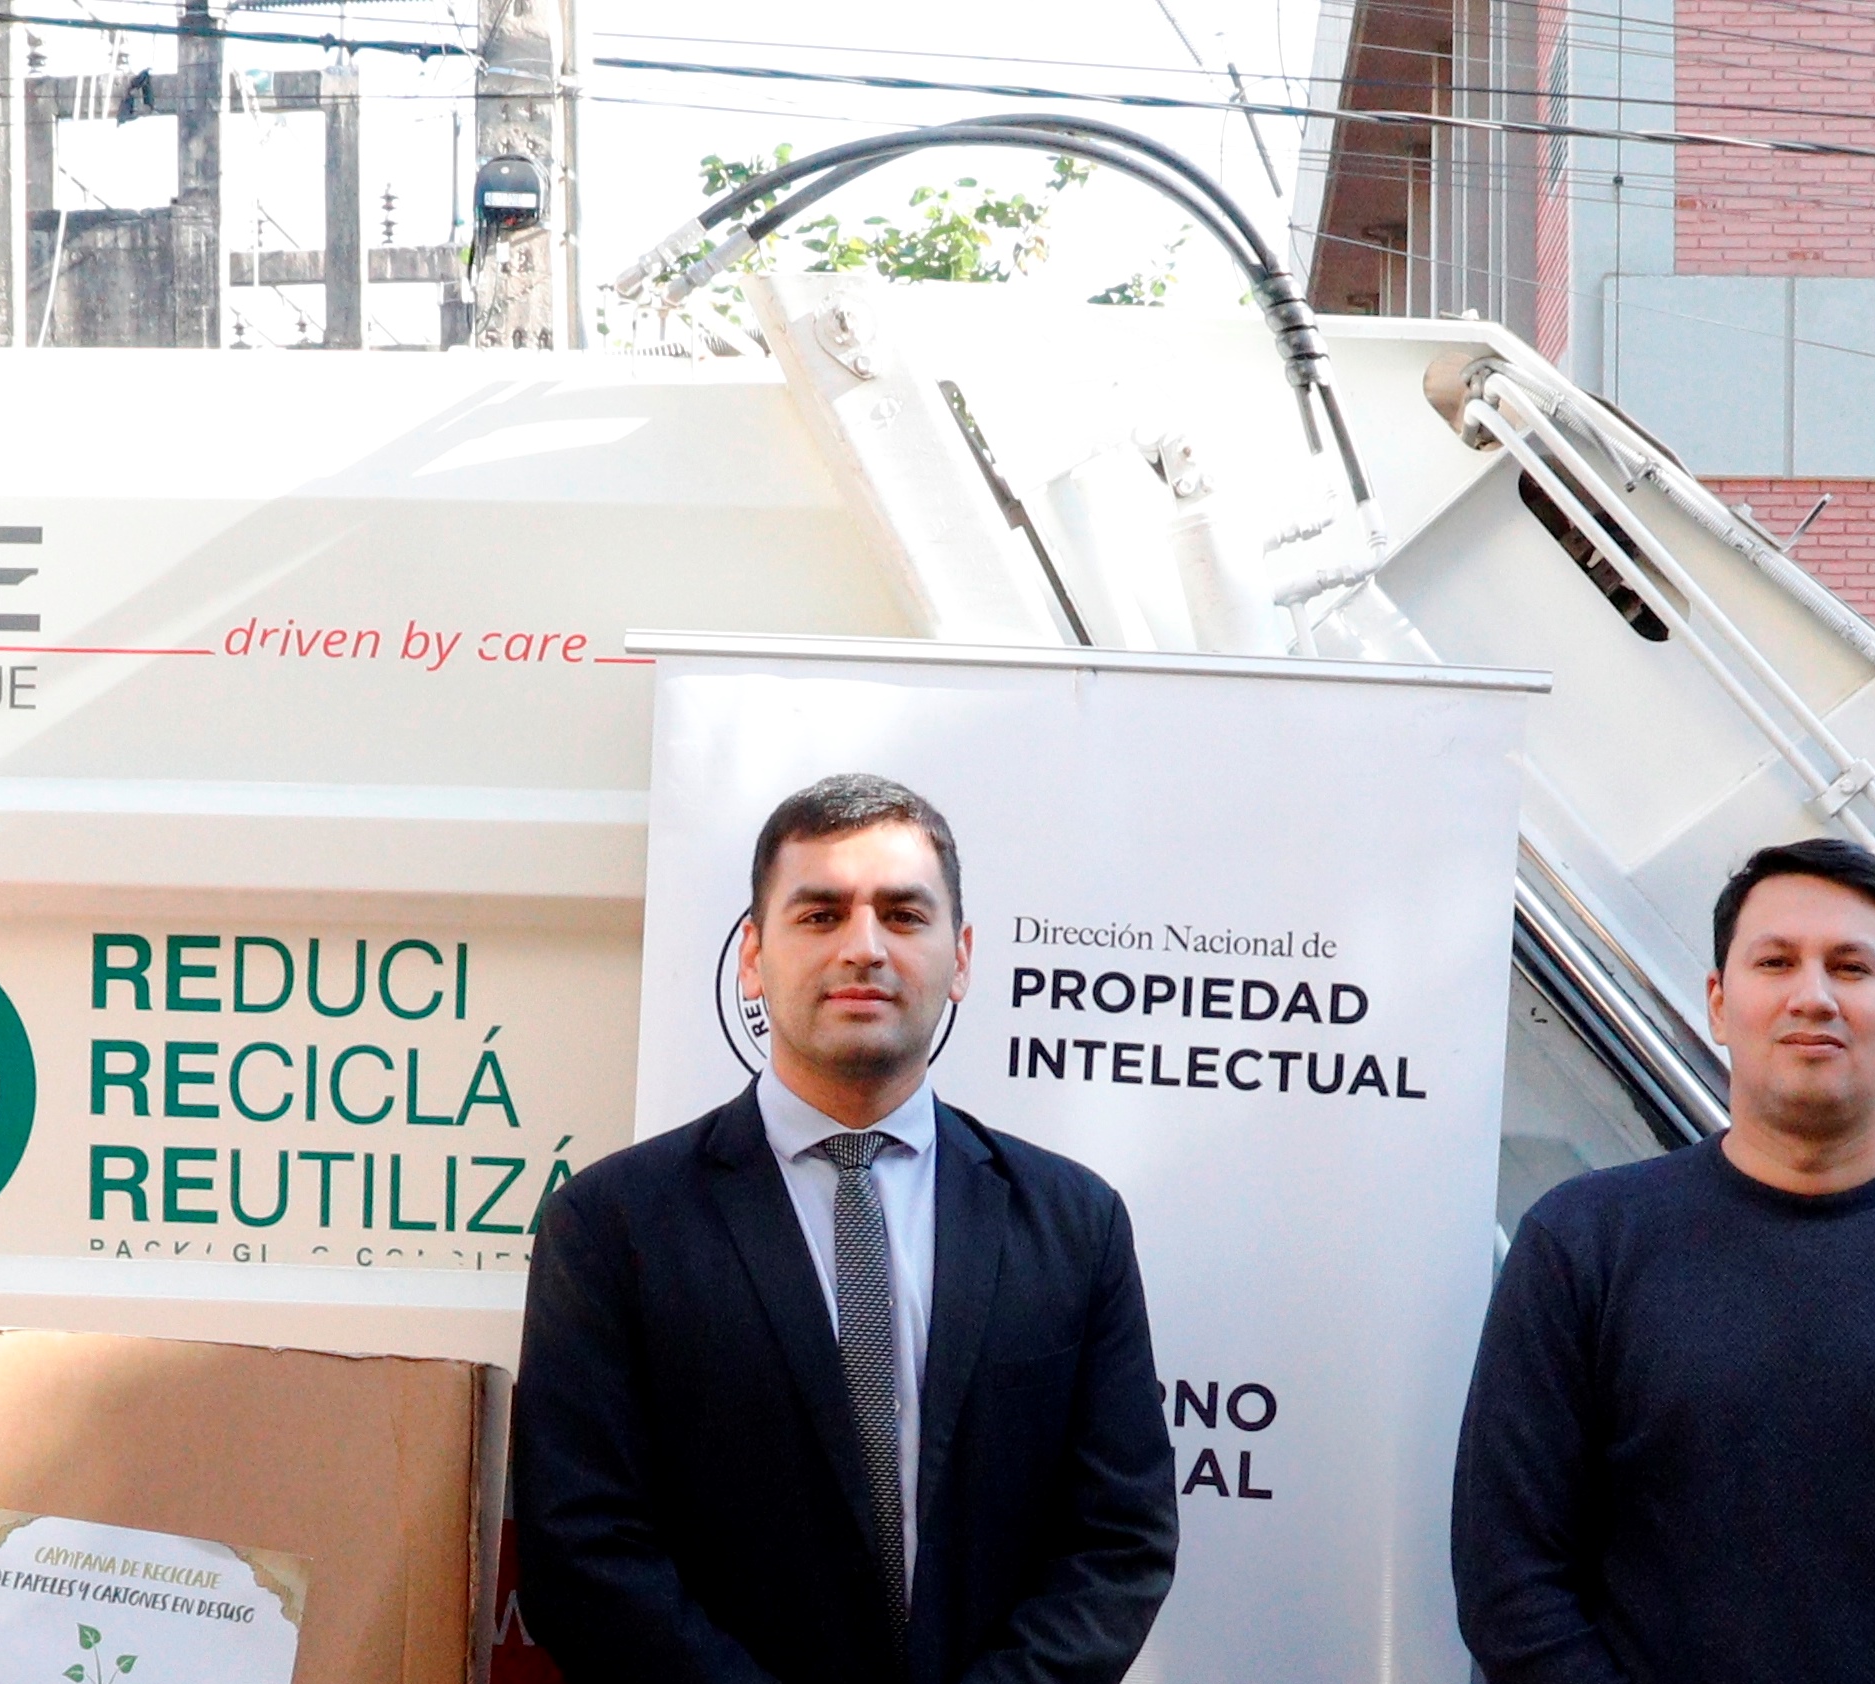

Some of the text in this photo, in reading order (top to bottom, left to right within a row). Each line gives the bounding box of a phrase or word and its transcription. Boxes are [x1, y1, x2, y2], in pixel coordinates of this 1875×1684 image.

[223, 617, 588, 671] driven by care
[1012, 916, 1338, 960] Dirección Nacional de
[90, 932, 469, 1021] REDUCI
[1011, 966, 1370, 1026] PROPIEDAD
[89, 1025, 521, 1129] RECICLÁ
[1008, 1036, 1428, 1100] INTELECTUAL
[12, 1570, 76, 1598] PAPELES
[77, 1580, 91, 1601] Y
[92, 1583, 172, 1612] CARTONES
[171, 1595, 195, 1616] EN
[196, 1600, 256, 1624] DESUSO
[119, 1559, 140, 1578] DE
[142, 1562, 222, 1590] RECICLAJE
